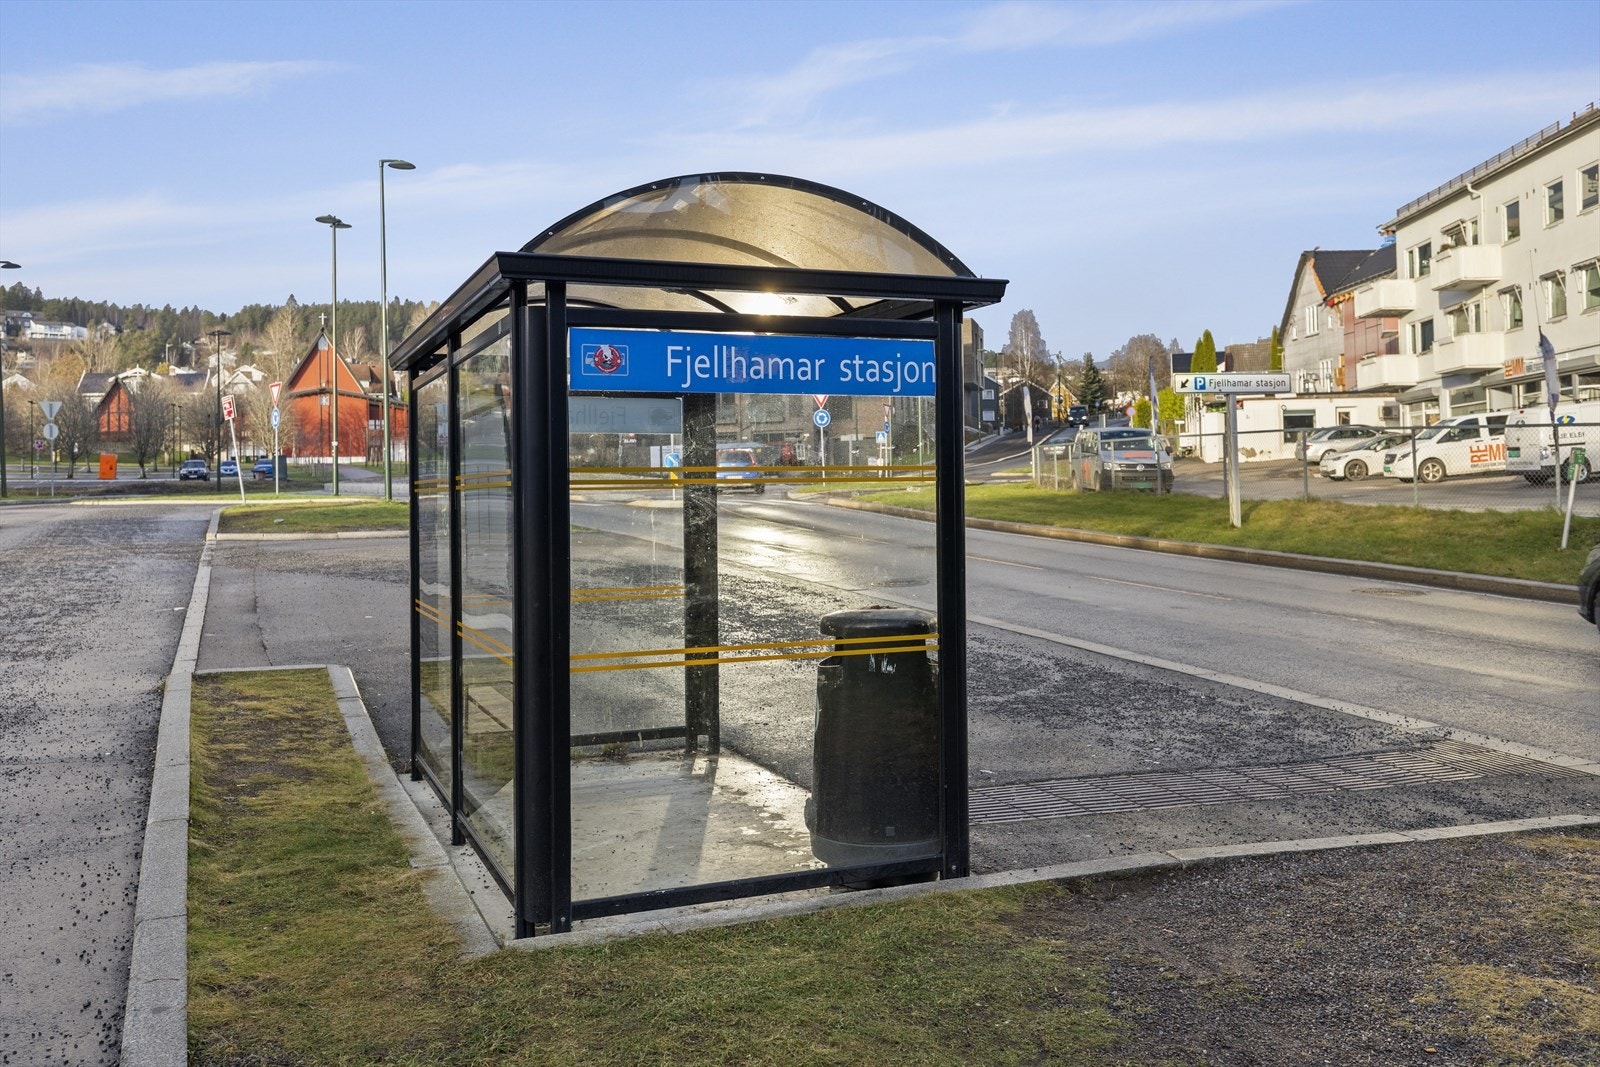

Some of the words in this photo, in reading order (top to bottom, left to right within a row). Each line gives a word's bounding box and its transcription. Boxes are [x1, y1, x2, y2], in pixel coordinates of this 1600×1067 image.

[666, 345, 825, 388] Fjellhamar
[839, 353, 936, 393] stasjon
[1209, 379, 1252, 389] Fjellhamar
[1256, 379, 1286, 389] stasjon
